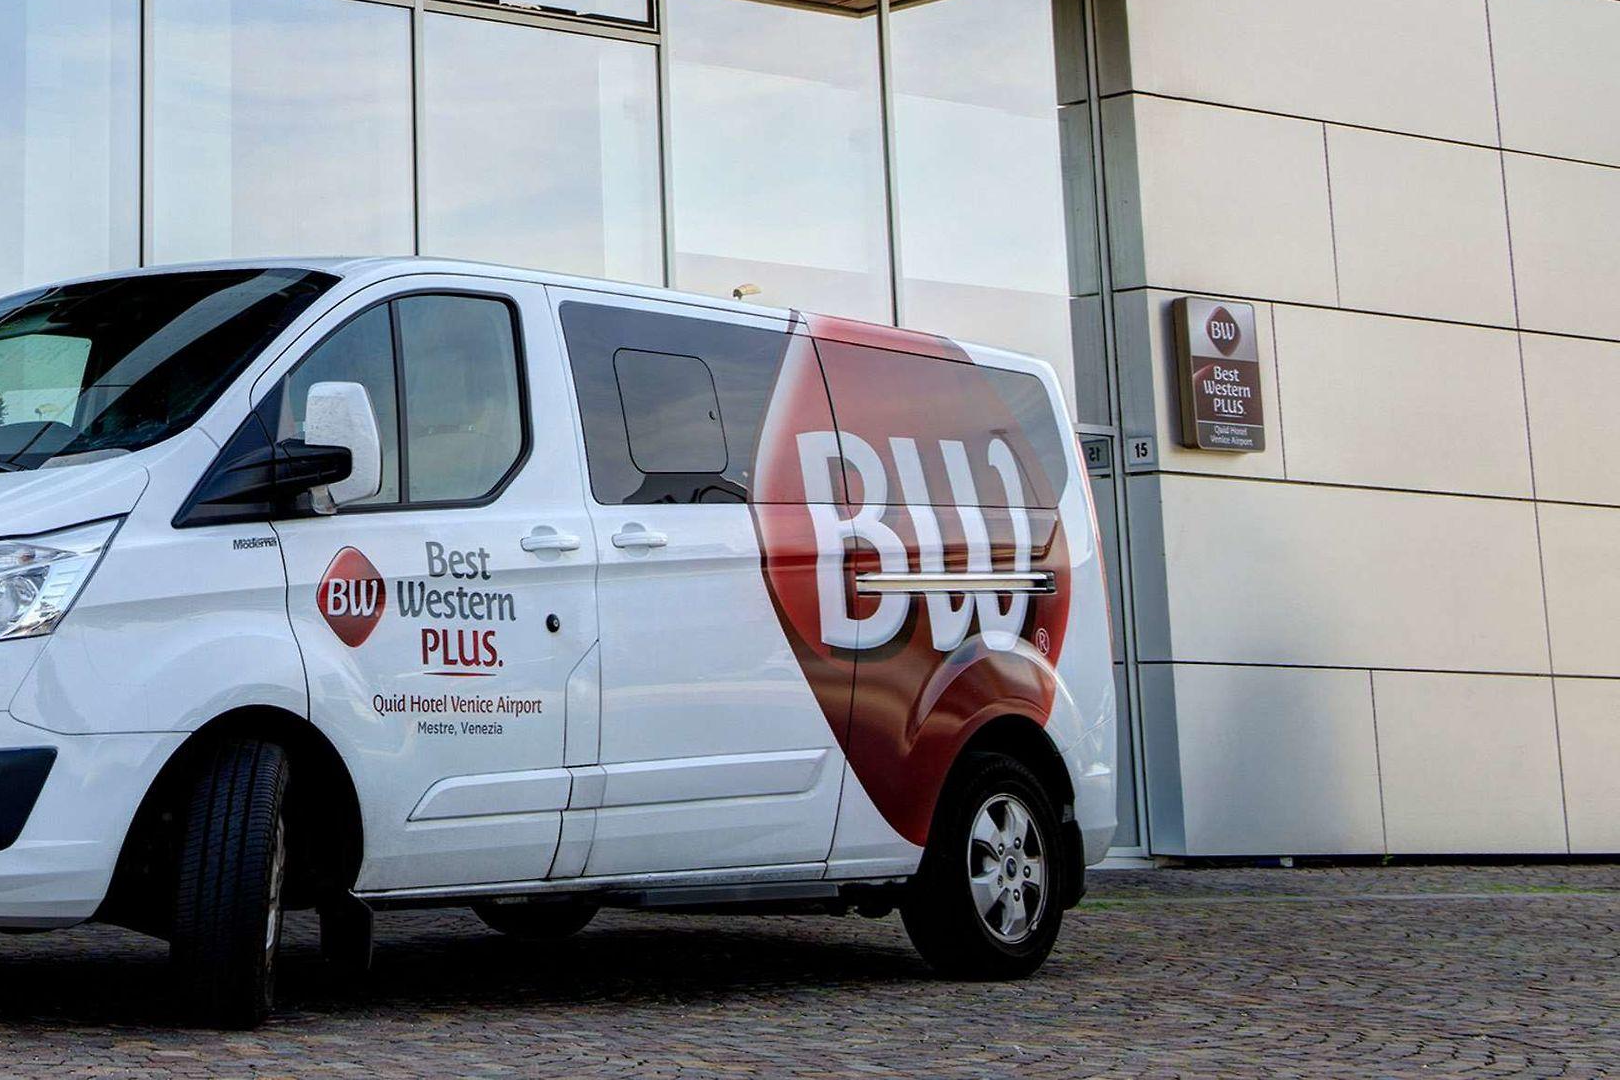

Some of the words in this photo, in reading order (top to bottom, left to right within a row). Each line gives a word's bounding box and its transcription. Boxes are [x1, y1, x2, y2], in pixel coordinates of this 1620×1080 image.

[1210, 320, 1236, 341] BW
[1213, 365, 1240, 382] Best
[1203, 380, 1251, 398] Western
[1133, 441, 1148, 459] 15
[796, 430, 1031, 652] BW
[425, 541, 493, 581] Best
[327, 578, 378, 617] BW
[396, 580, 517, 622] Western
[372, 693, 406, 717] Quid
[410, 694, 447, 713] Hotel
[450, 695, 494, 714] Venice
[496, 696, 543, 718] Airport
[417, 721, 457, 736] Mestre,
[460, 721, 504, 735] Venezia
